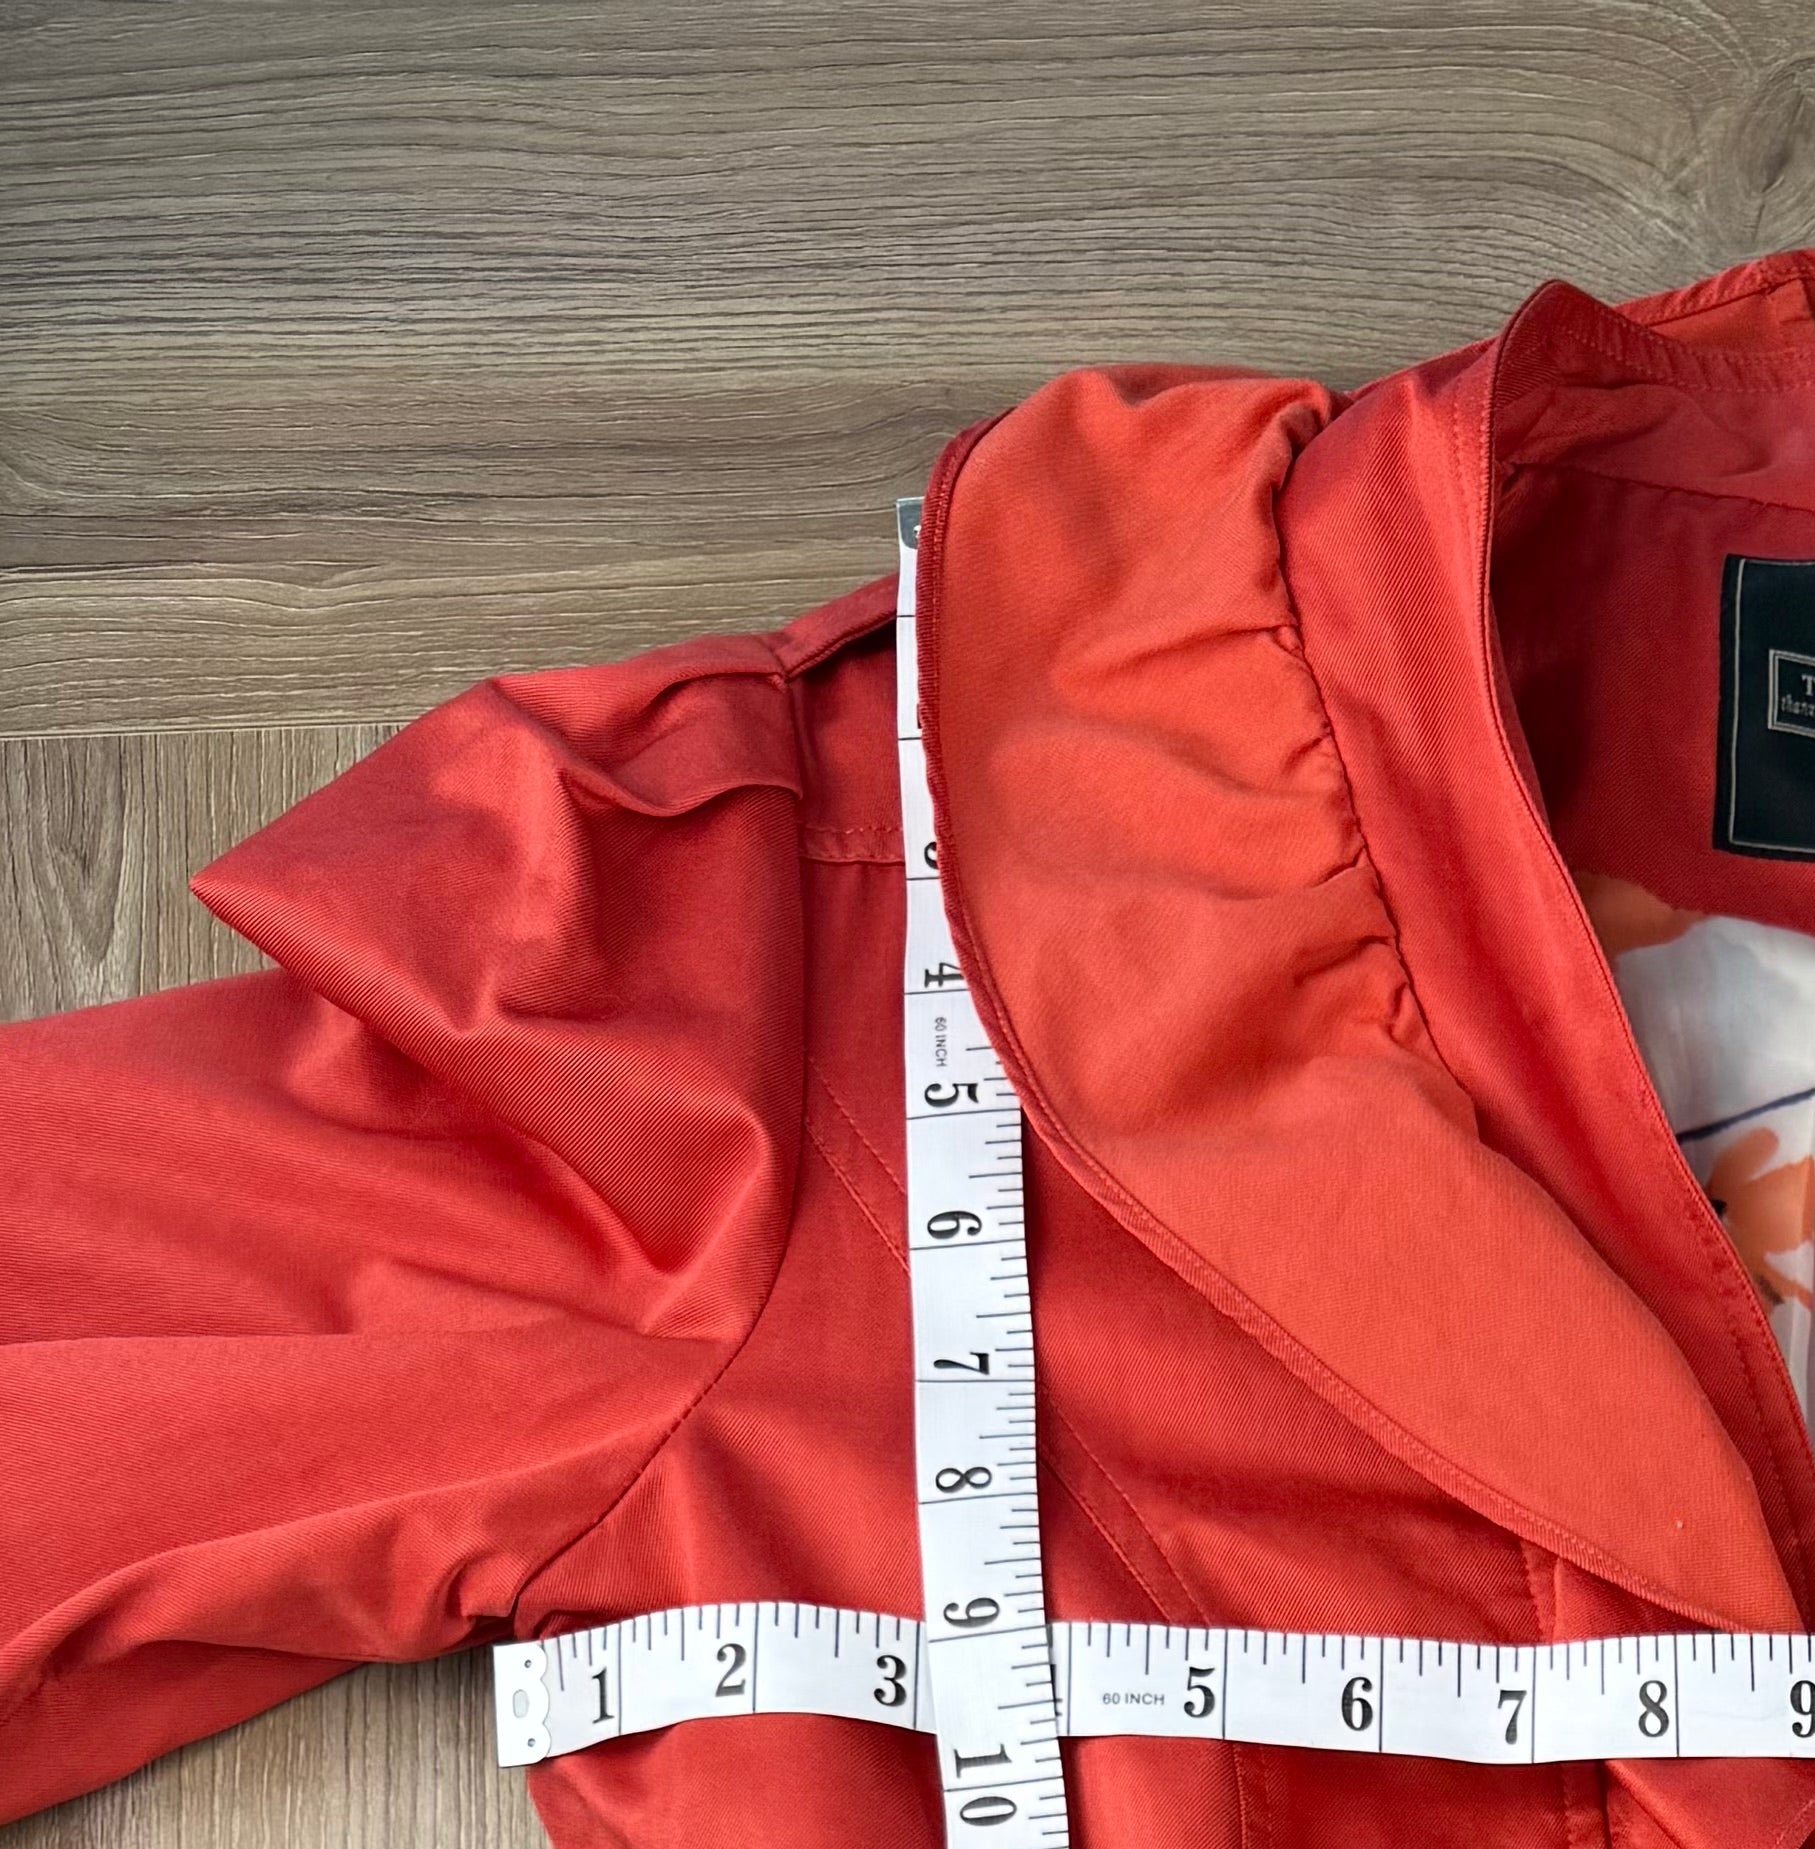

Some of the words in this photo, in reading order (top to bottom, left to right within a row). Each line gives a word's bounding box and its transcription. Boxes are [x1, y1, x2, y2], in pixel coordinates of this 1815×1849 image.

[923, 961, 965, 989] 4
[934, 1016, 948, 1032] 60
[935, 1034, 948, 1068] INCH
[924, 1082, 979, 1108] 5
[926, 1210, 983, 1240] 6
[933, 1351, 990, 1376] 7
[935, 1466, 993, 1494] 8
[943, 1597, 1000, 1628] 9
[591, 1668, 614, 1724] 1
[715, 1642, 746, 1698] 2
[873, 1654, 907, 1707] 3
[1183, 1666, 1215, 1719] 5
[1341, 1676, 1374, 1732] 6
[1497, 1689, 1527, 1745] 7
[1638, 1679, 1670, 1738] 8
[1102, 1692, 1121, 1705] 60
[1124, 1692, 1165, 1705] INCH
[953, 1743, 1018, 1827] 10
